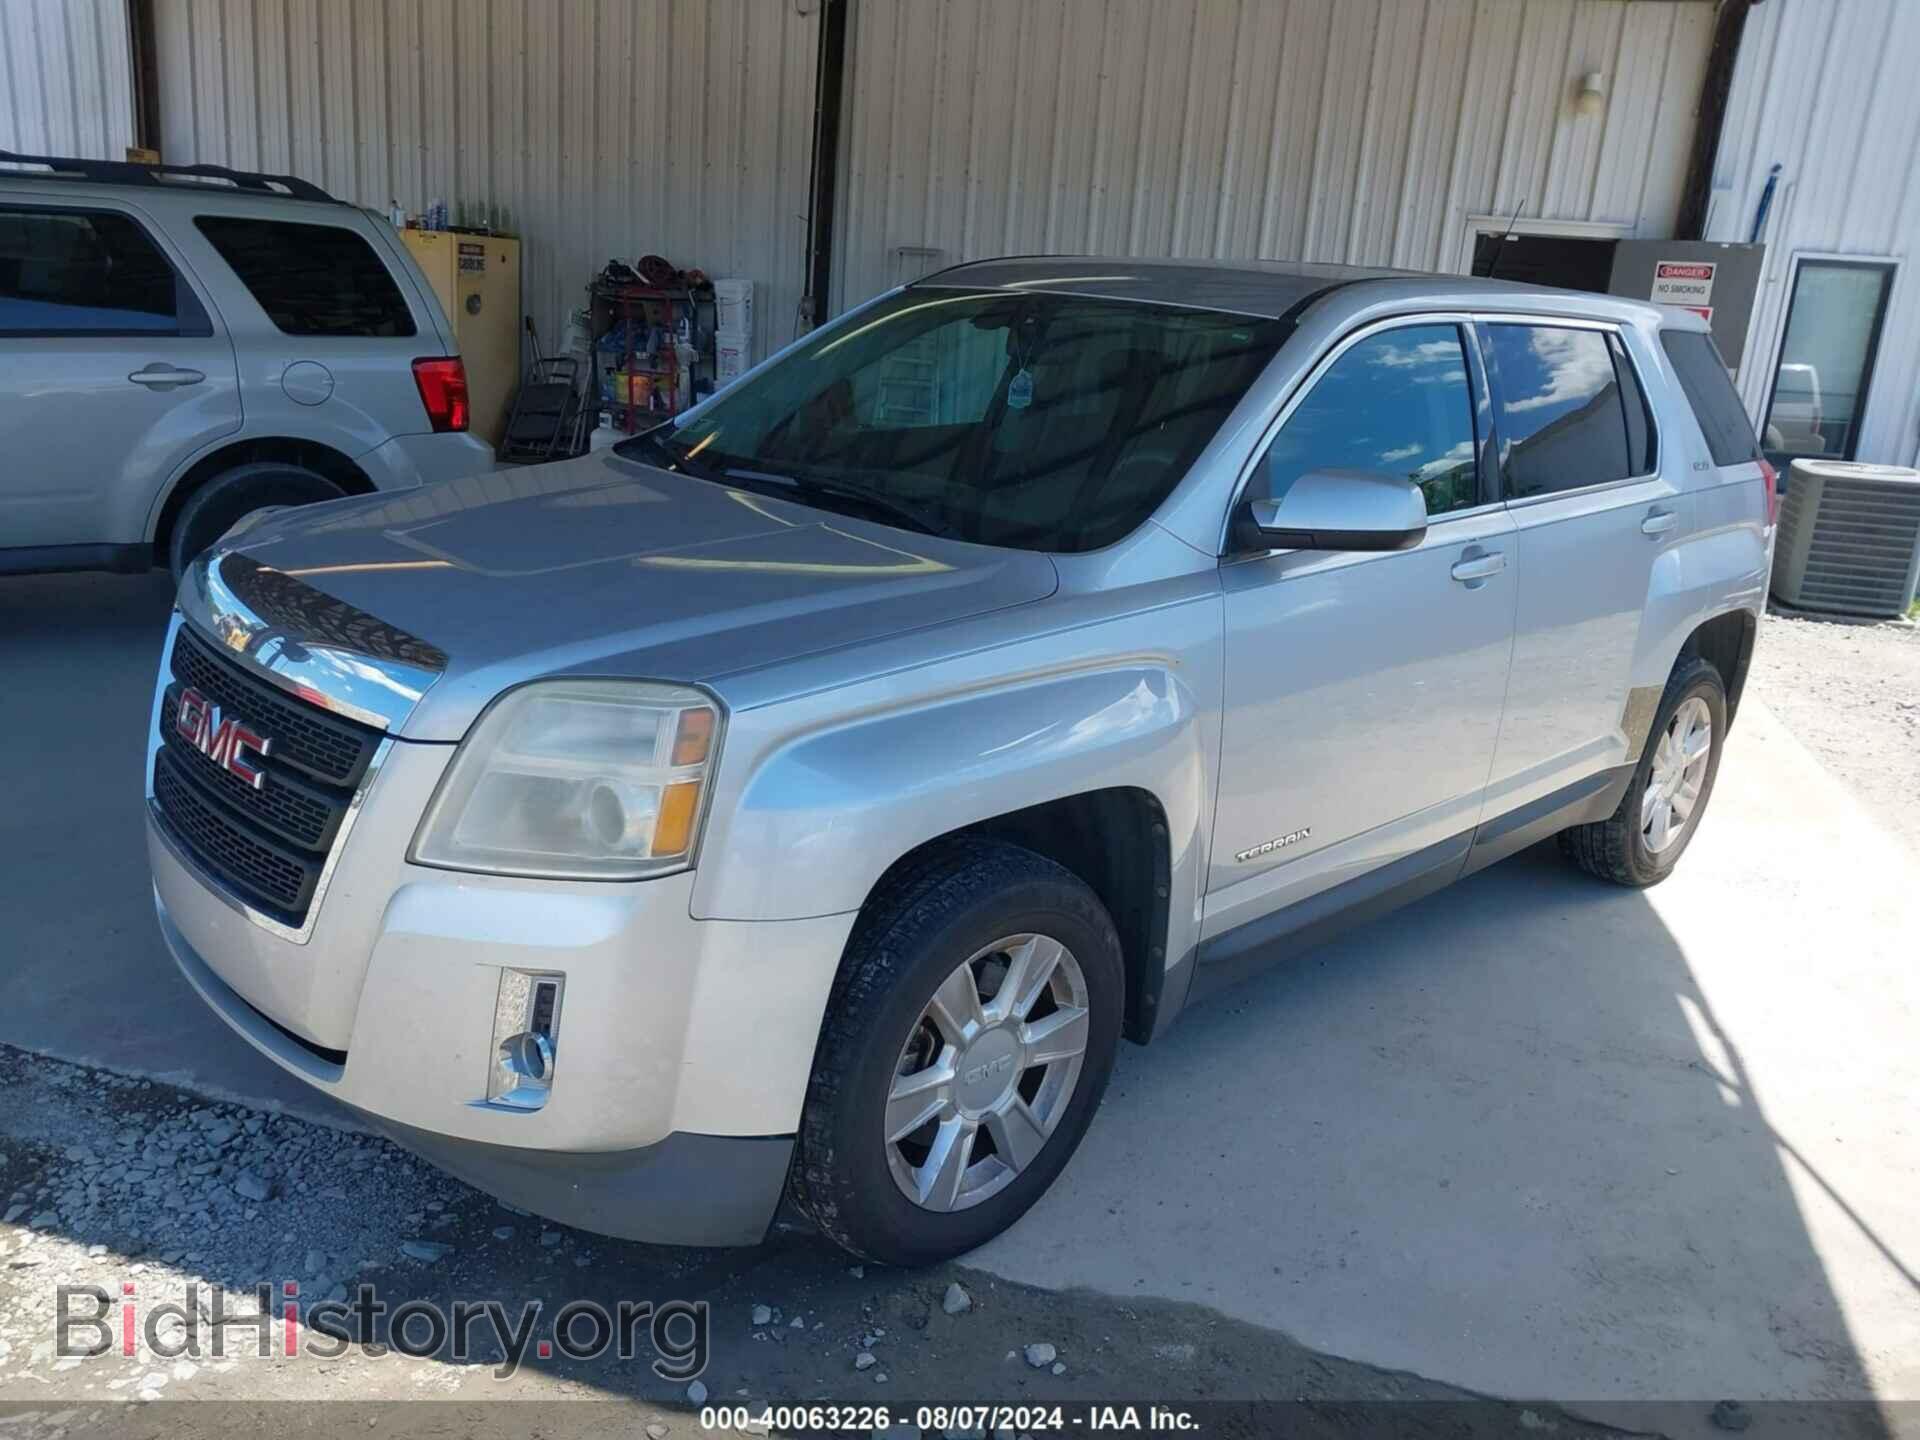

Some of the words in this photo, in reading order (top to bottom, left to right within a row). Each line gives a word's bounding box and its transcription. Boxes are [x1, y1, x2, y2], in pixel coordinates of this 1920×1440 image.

[1665, 266, 1706, 277] DANGER
[1658, 284, 1669, 293] NO
[1671, 284, 1706, 294] SMOKING
[176, 686, 271, 790] GMC
[1235, 827, 1311, 862] TERRAIN
[964, 1054, 1011, 1086] GMC
